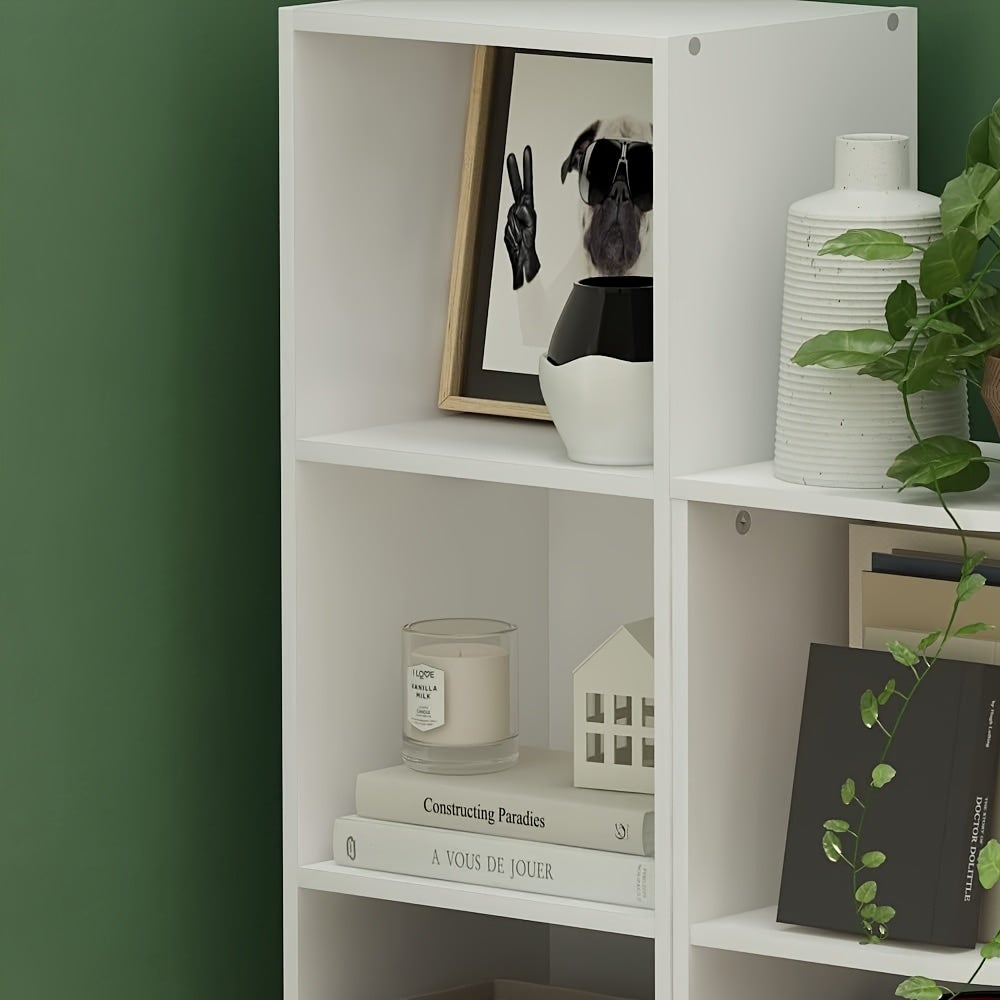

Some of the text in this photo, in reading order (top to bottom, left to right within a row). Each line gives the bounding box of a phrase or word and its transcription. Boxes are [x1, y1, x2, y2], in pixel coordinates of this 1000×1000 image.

[423, 797, 546, 828] Constructing Paradies
[431, 848, 554, 880] A VOUS DE JOUER
[964, 796, 983, 902] DOCTOR DOLITTLE
